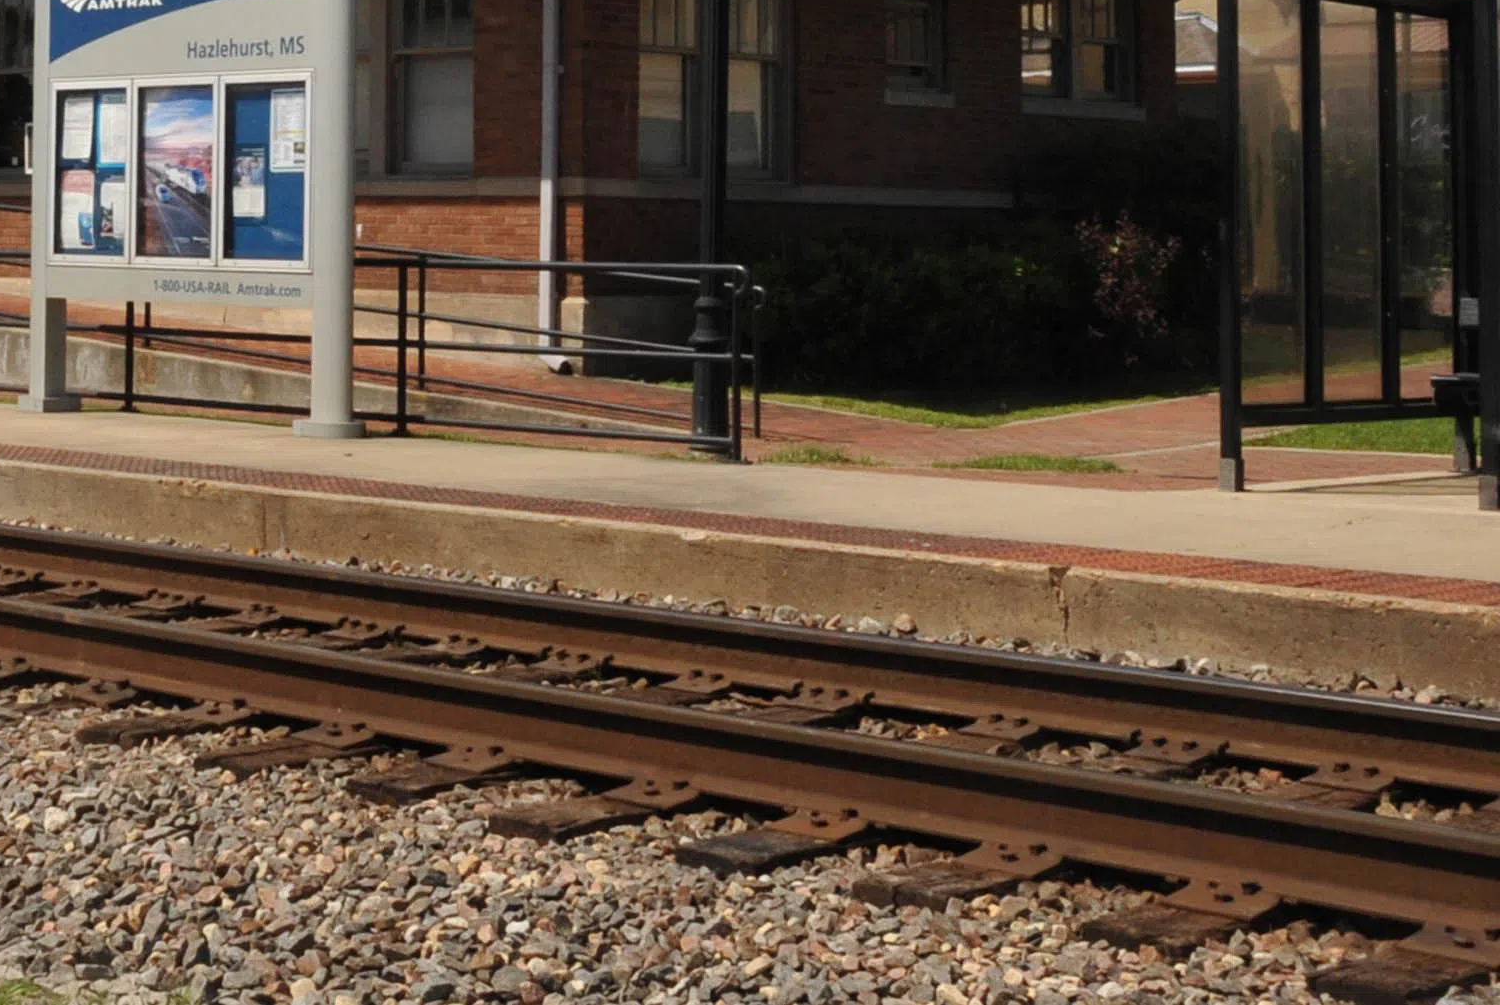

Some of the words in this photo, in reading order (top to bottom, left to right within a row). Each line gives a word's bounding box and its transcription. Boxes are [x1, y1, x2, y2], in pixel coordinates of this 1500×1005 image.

[187, 39, 274, 59] Hazlehurst,
[280, 36, 305, 55] MS
[153, 280, 230, 294] 1-800-USA-RAIL
[237, 282, 301, 297] Amtrak.com
